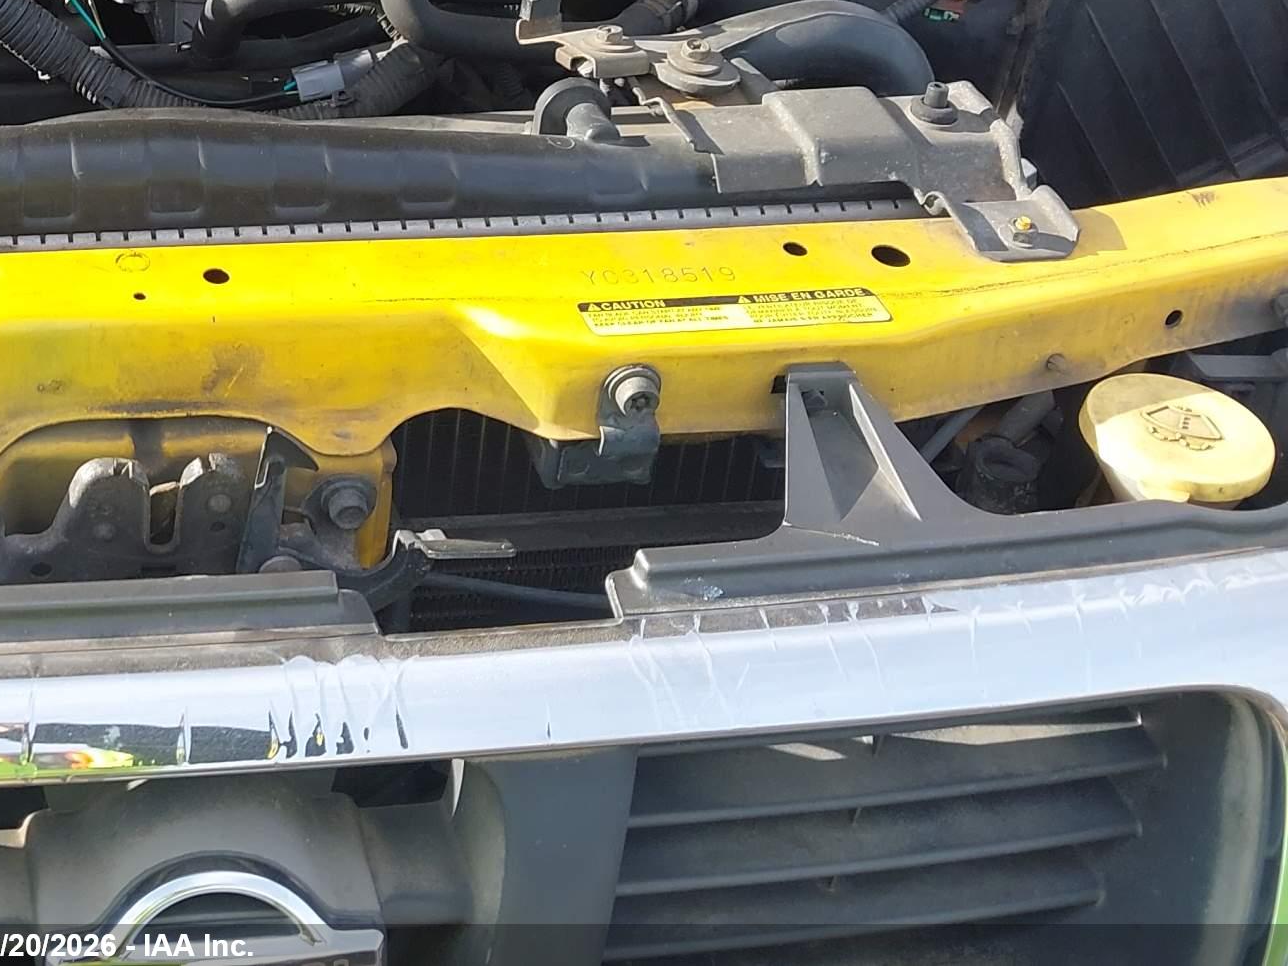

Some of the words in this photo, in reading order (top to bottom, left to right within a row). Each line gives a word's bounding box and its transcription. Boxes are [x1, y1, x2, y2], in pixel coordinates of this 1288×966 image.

[752, 293, 790, 304] MISE
[790, 291, 812, 301] EN
[813, 287, 866, 300] GARDE
[600, 299, 666, 312] CAUTION
